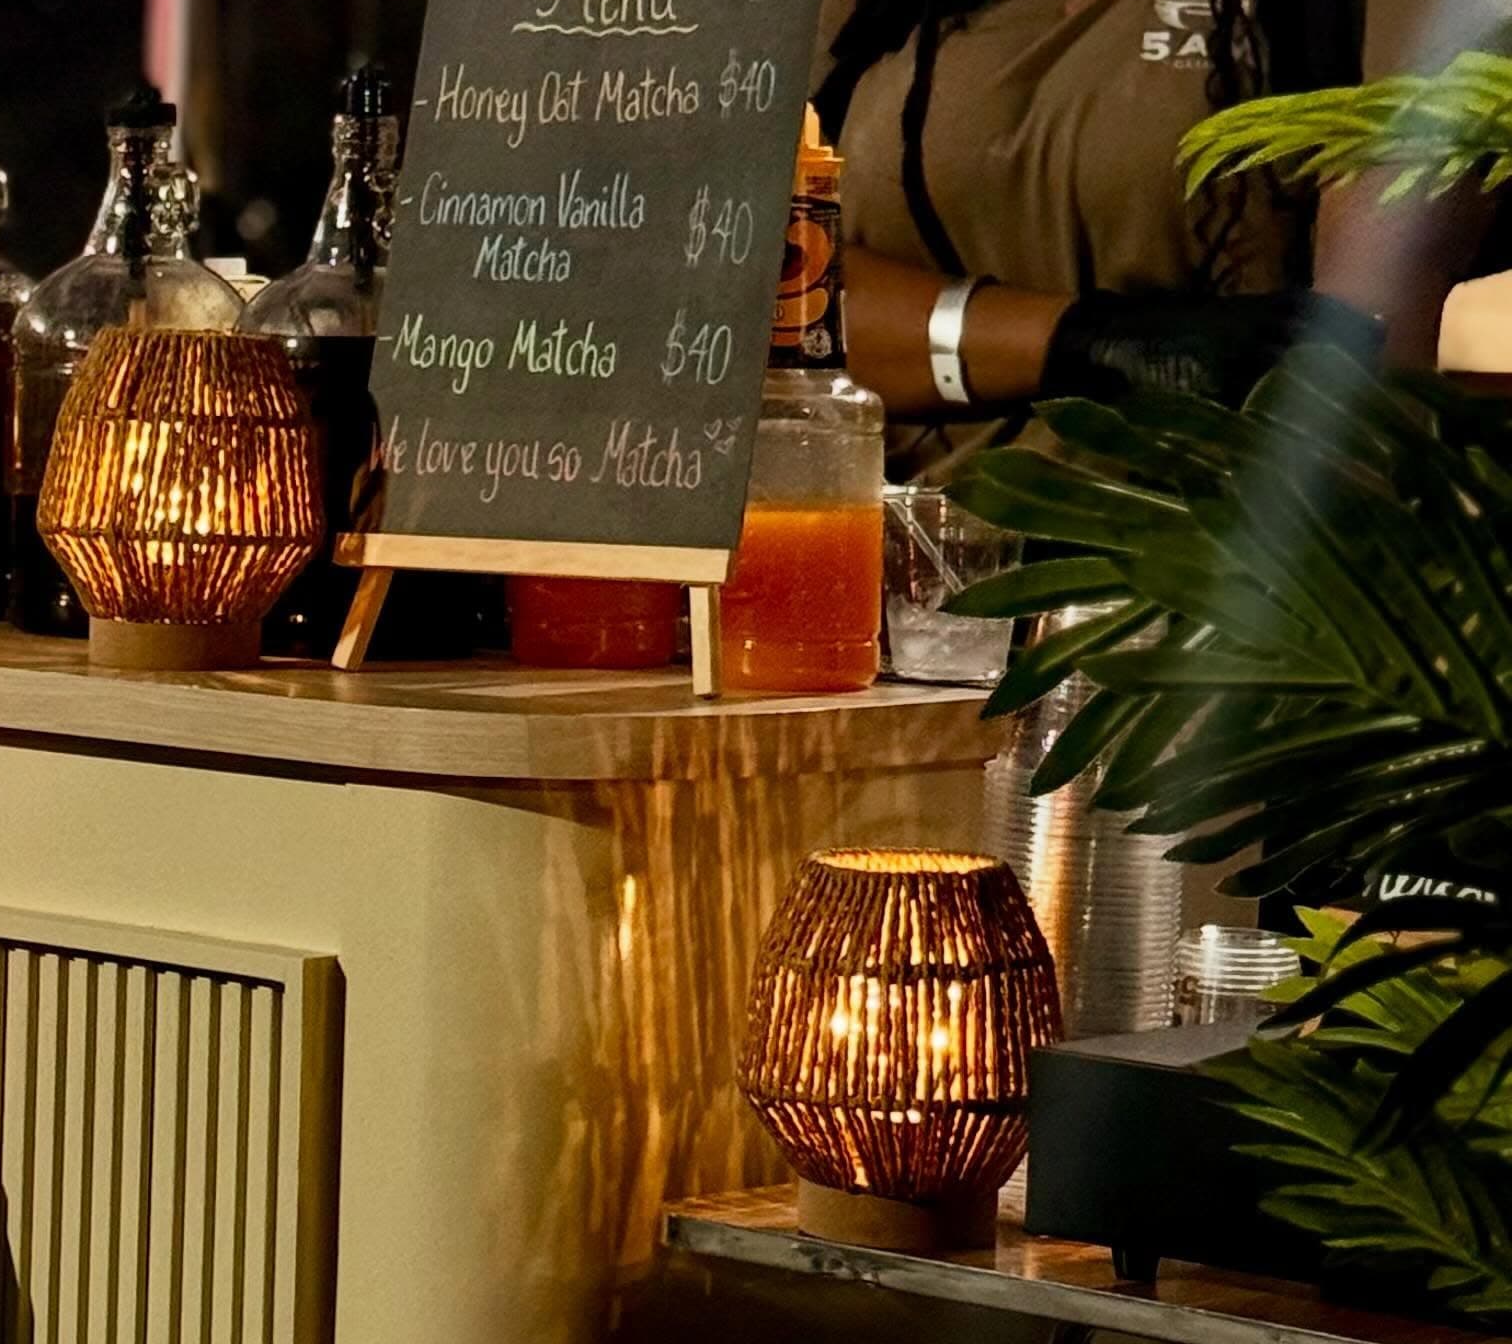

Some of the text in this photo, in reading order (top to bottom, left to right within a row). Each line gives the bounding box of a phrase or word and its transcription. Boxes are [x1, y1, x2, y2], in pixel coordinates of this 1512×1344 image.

[538, 70, 586, 124] Oat
[595, 66, 699, 123] Matcha
[719, 48, 776, 119] $40
[558, 169, 645, 229] Vanilla
[685, 185, 753, 268] $40
[473, 233, 571, 282] Matcha
[508, 319, 616, 378] Matcha
[660, 309, 731, 385] $40
[369, 416, 701, 503] We love you so Matcha
